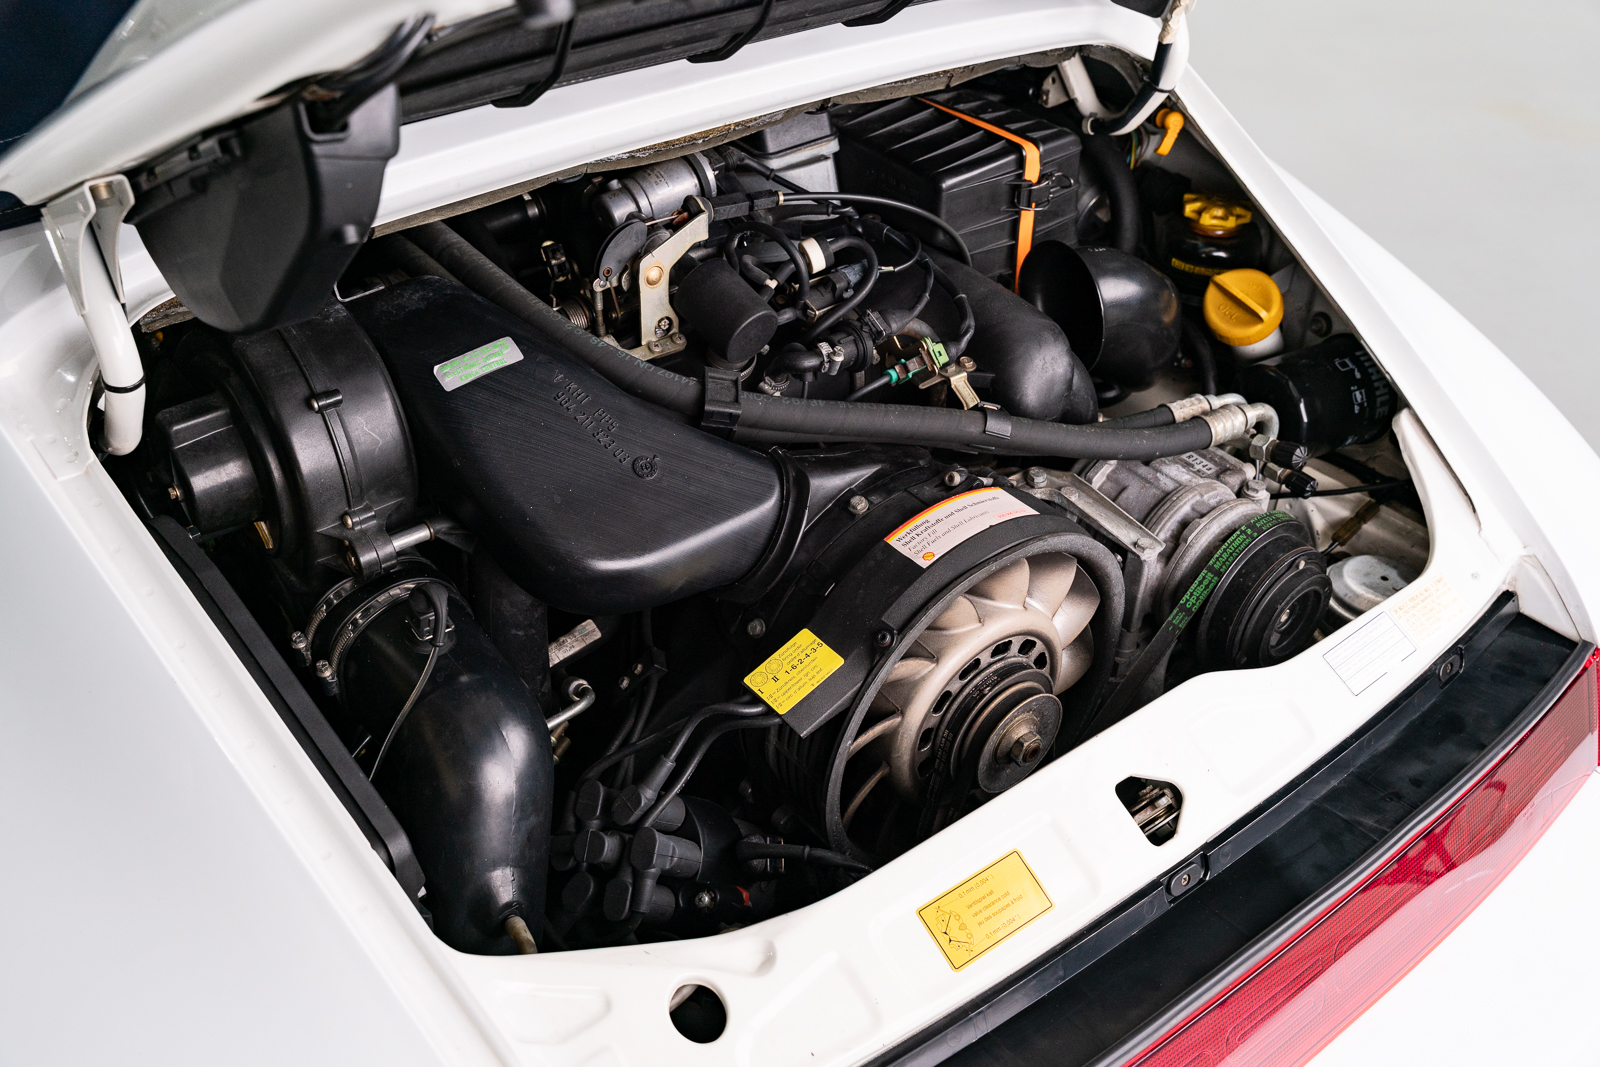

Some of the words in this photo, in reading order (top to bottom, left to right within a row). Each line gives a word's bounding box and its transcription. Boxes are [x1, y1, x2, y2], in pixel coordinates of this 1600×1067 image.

[445, 359, 481, 379] ELECTRONIC
[459, 368, 479, 382] KNOCK
[480, 357, 508, 372] CONTROL
[552, 389, 577, 414] 964
[590, 426, 616, 451] 323
[1184, 571, 1214, 608] optibelt
[1212, 531, 1247, 570] MARATHON
[1244, 526, 1253, 535] 2
[770, 674, 780, 683] II
[783, 640, 824, 676] 1-6-2-4-3-5
[981, 895, 1002, 911] clearance
